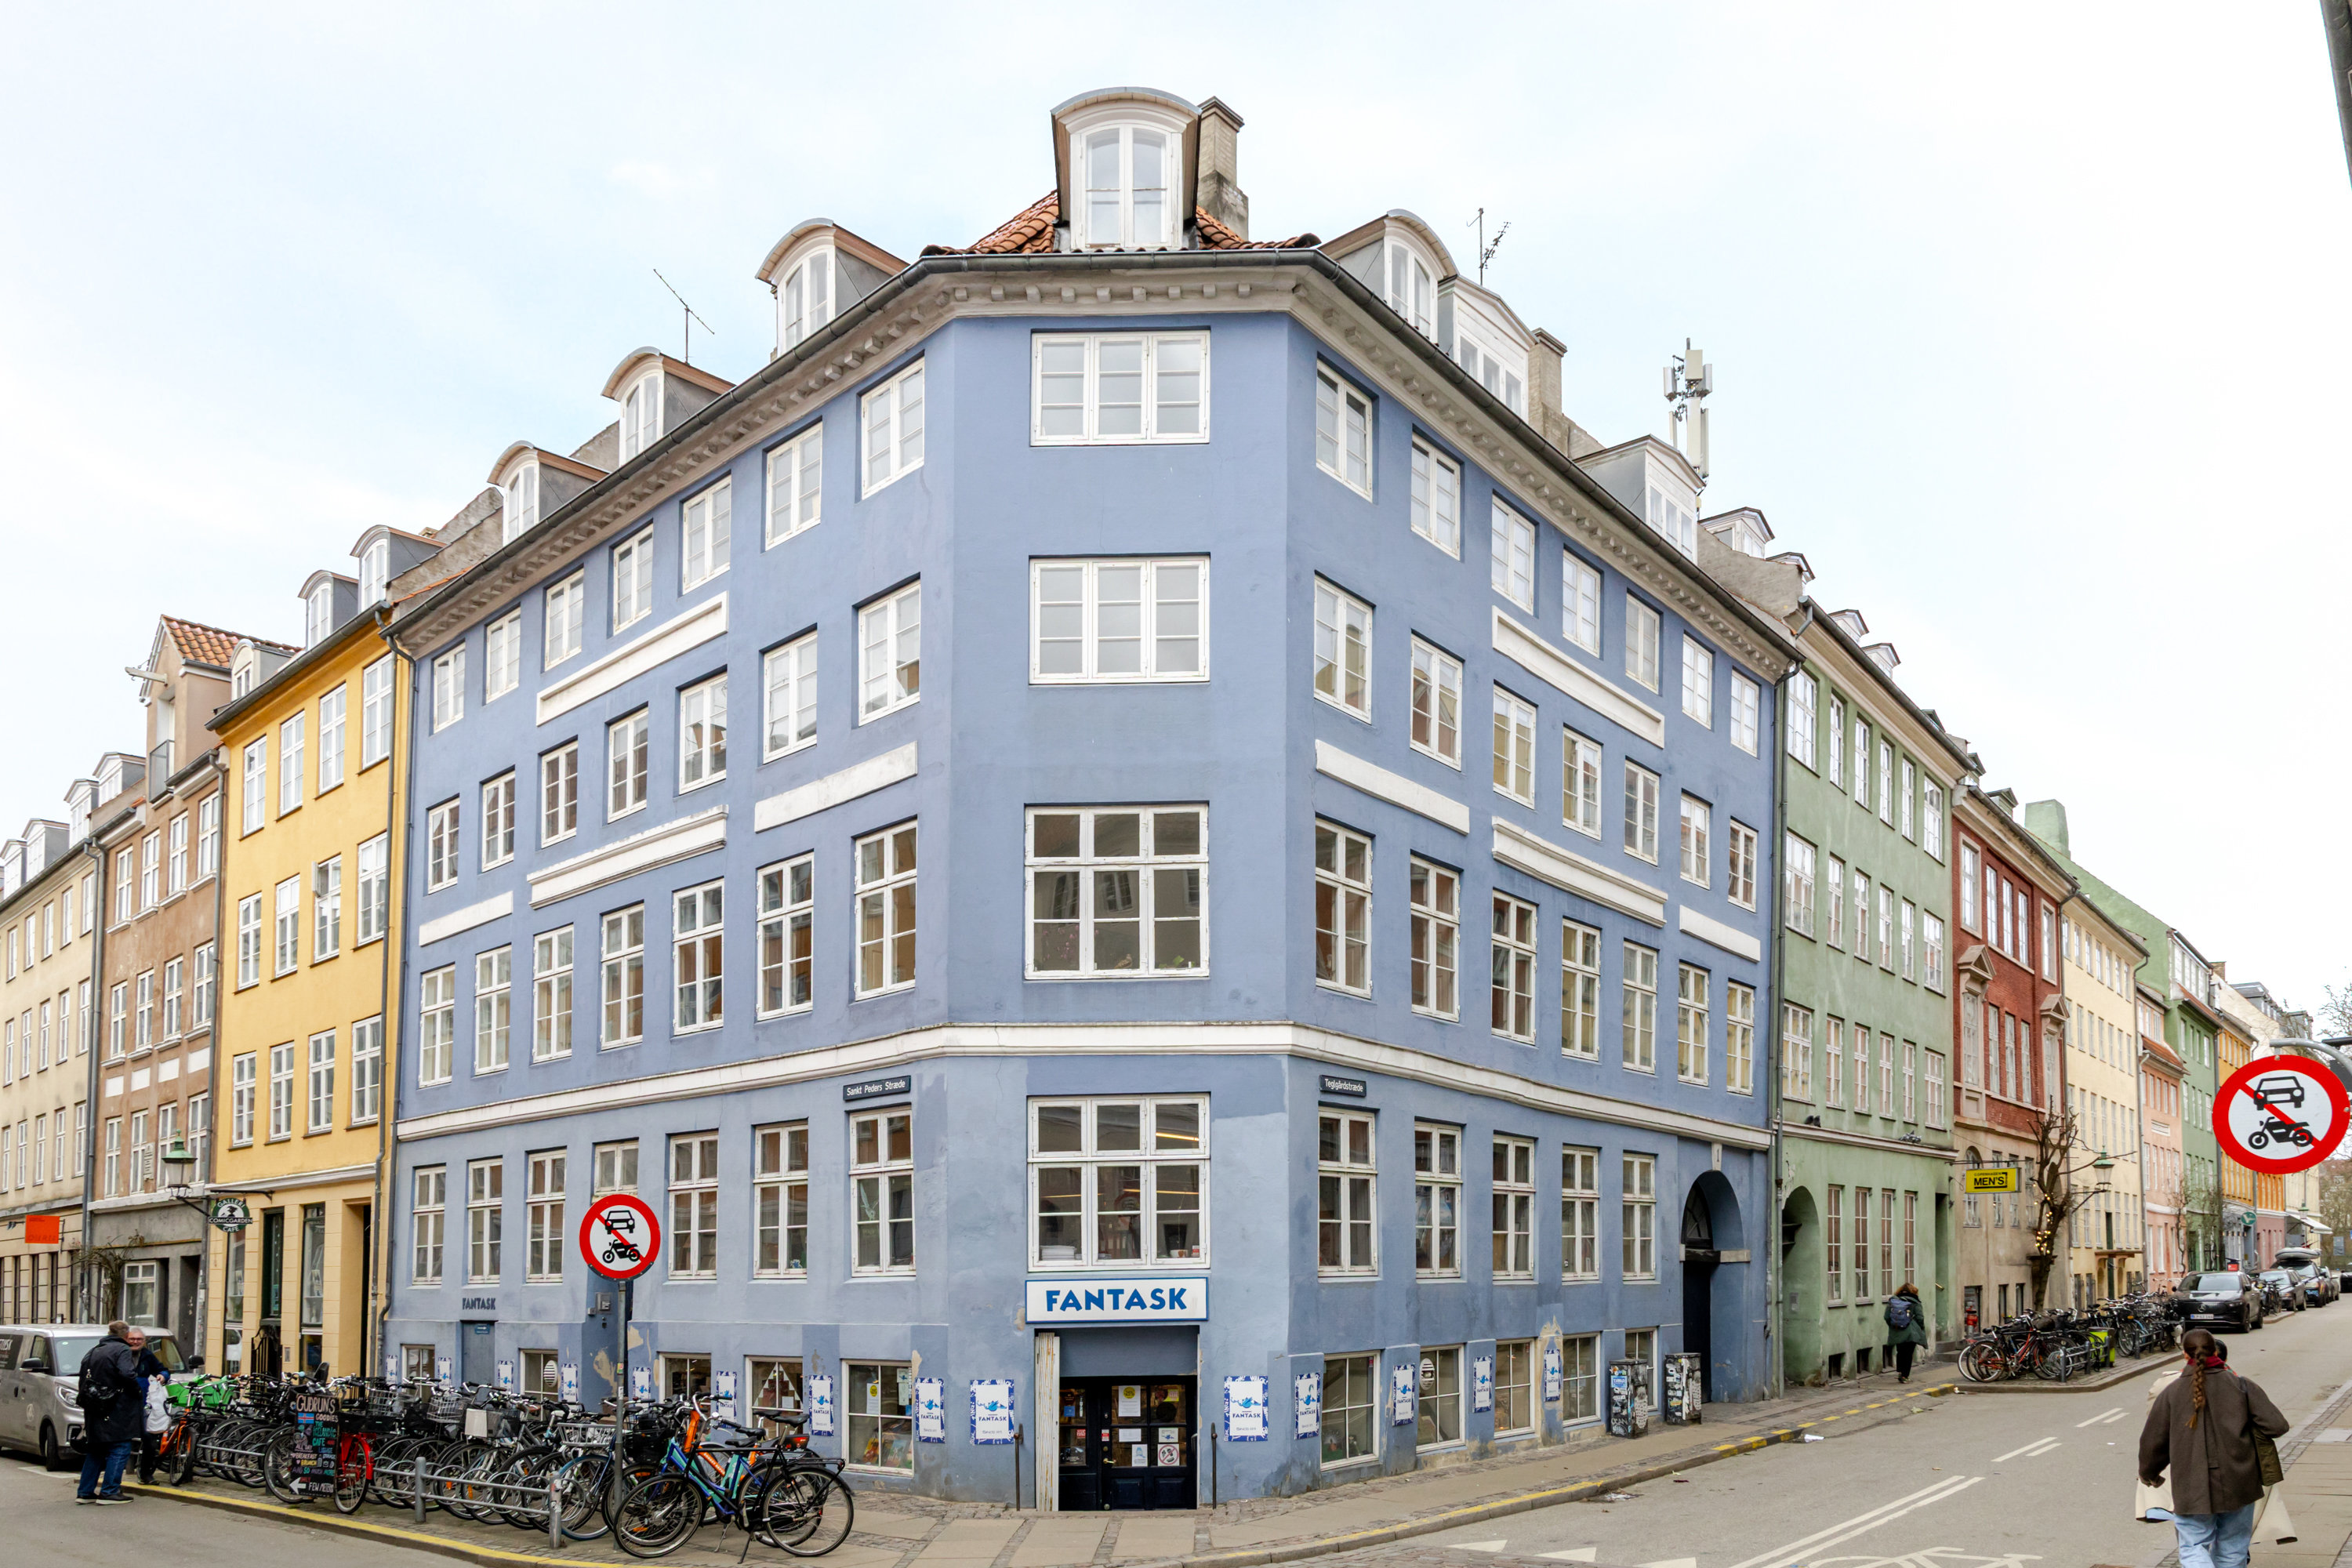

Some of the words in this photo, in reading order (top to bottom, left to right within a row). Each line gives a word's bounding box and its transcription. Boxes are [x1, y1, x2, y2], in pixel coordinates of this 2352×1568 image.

[847, 1086, 862, 1096] Sankt
[864, 1084, 883, 1094] Peders
[885, 1080, 906, 1090] Stræde
[1974, 1177, 2005, 1186] MEN'S
[217, 1198, 245, 1208] GALLERI
[463, 1298, 496, 1310] FANTASK
[1046, 1288, 1187, 1312] FANTASK
[308, 1483, 319, 1491] FEW
